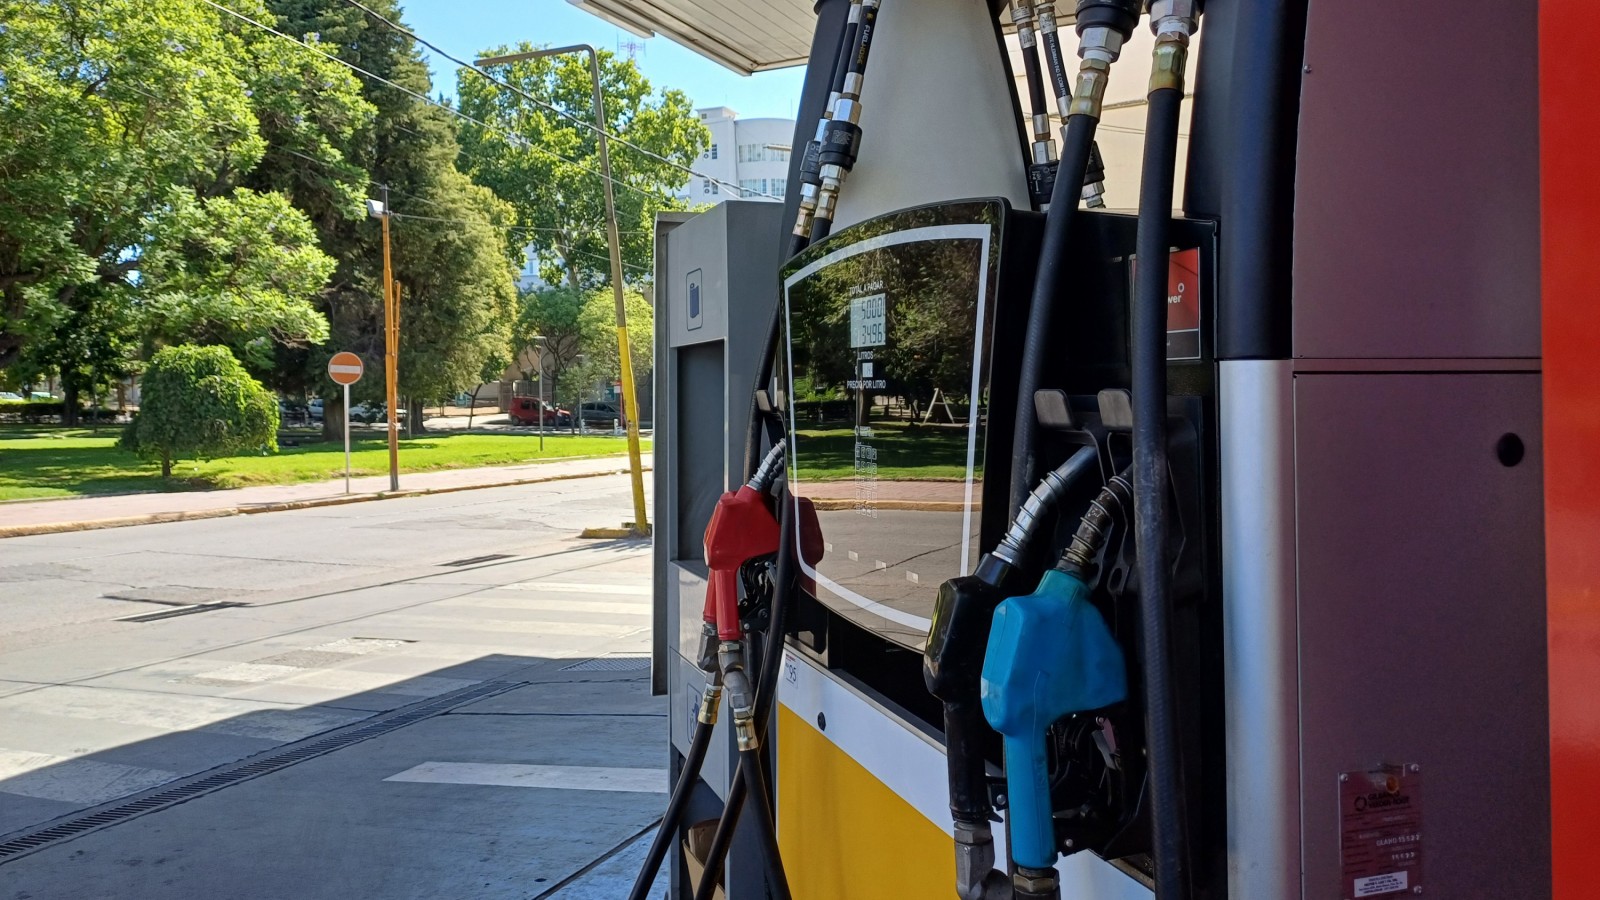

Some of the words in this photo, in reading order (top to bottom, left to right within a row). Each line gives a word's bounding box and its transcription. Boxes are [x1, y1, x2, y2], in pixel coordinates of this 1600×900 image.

[849, 285, 862, 295] TOTAL
[863, 380, 872, 389] POR
[873, 380, 887, 389] LITRO
